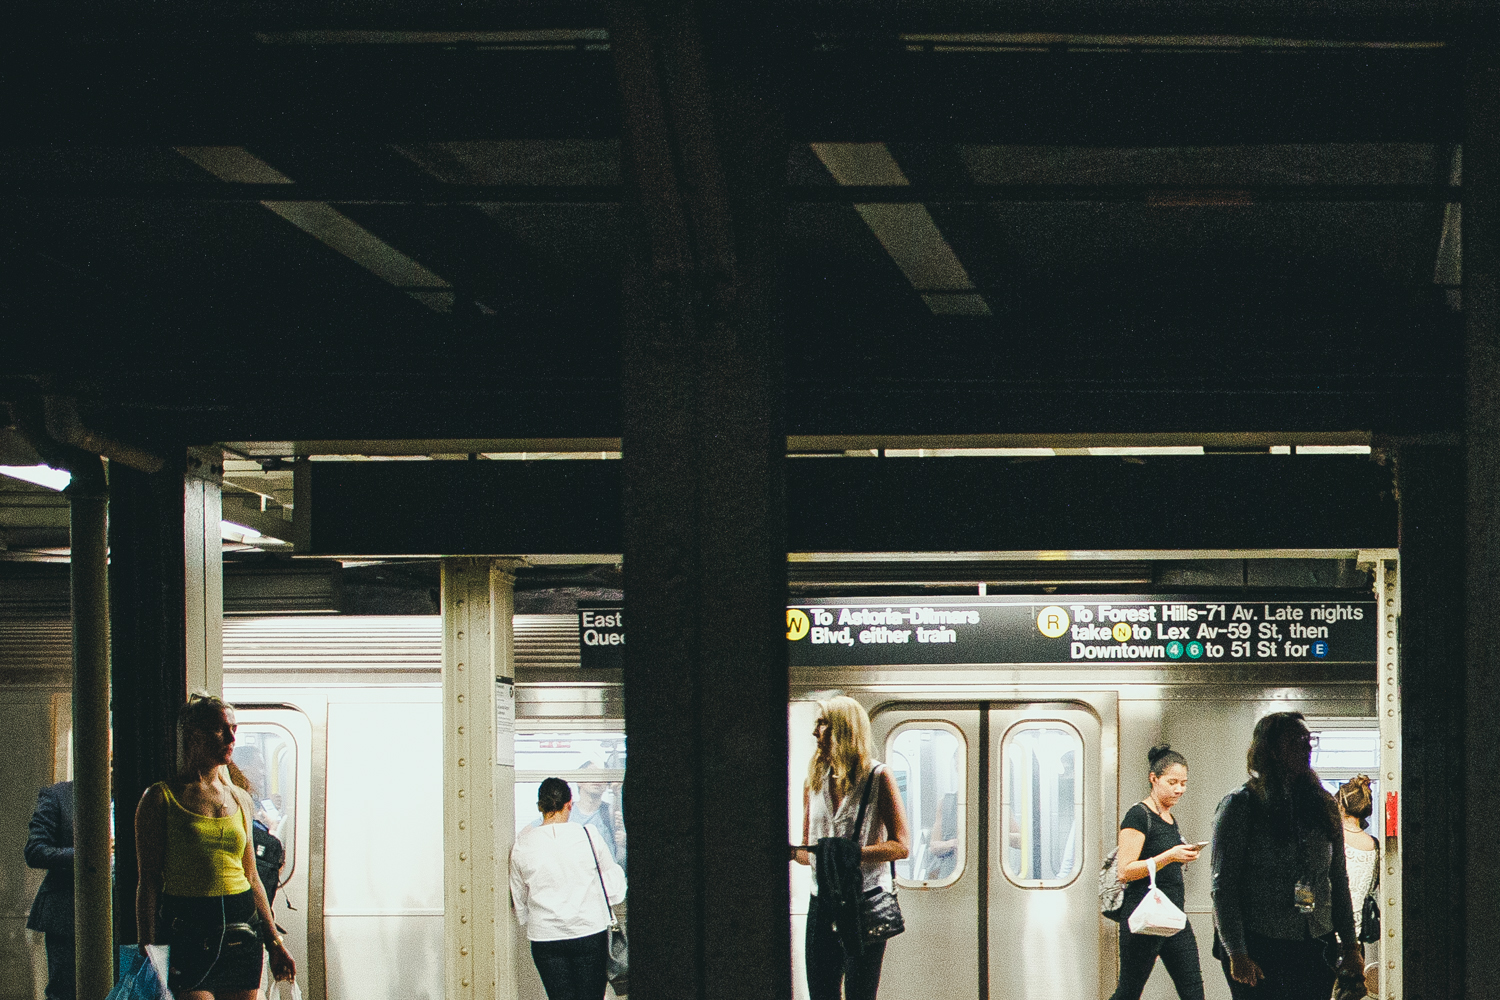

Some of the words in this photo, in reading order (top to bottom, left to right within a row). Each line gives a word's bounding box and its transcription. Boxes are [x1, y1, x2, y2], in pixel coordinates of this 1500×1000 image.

[582, 612, 622, 627] East
[810, 608, 833, 625] To
[1070, 606, 1093, 622] To
[1098, 605, 1156, 622] Forest
[1162, 605, 1226, 621] Hills-71
[1232, 605, 1258, 620] Av.
[1264, 605, 1303, 620] Late
[1310, 604, 1363, 623] nights
[811, 627, 854, 646] Blvd,
[859, 627, 911, 643] either
[916, 626, 957, 643] train
[1070, 623, 1112, 640] take
[1132, 624, 1151, 640] to
[1157, 623, 1190, 639] Lex
[1196, 622, 1251, 639] Av-59
[1258, 623, 1282, 641] St,
[1289, 623, 1328, 638] then
[1070, 642, 1165, 659] Downtown
[1205, 642, 1224, 657] to
[1230, 641, 1251, 657] 51
[1257, 641, 1277, 657] St
[1284, 641, 1309, 657] for
